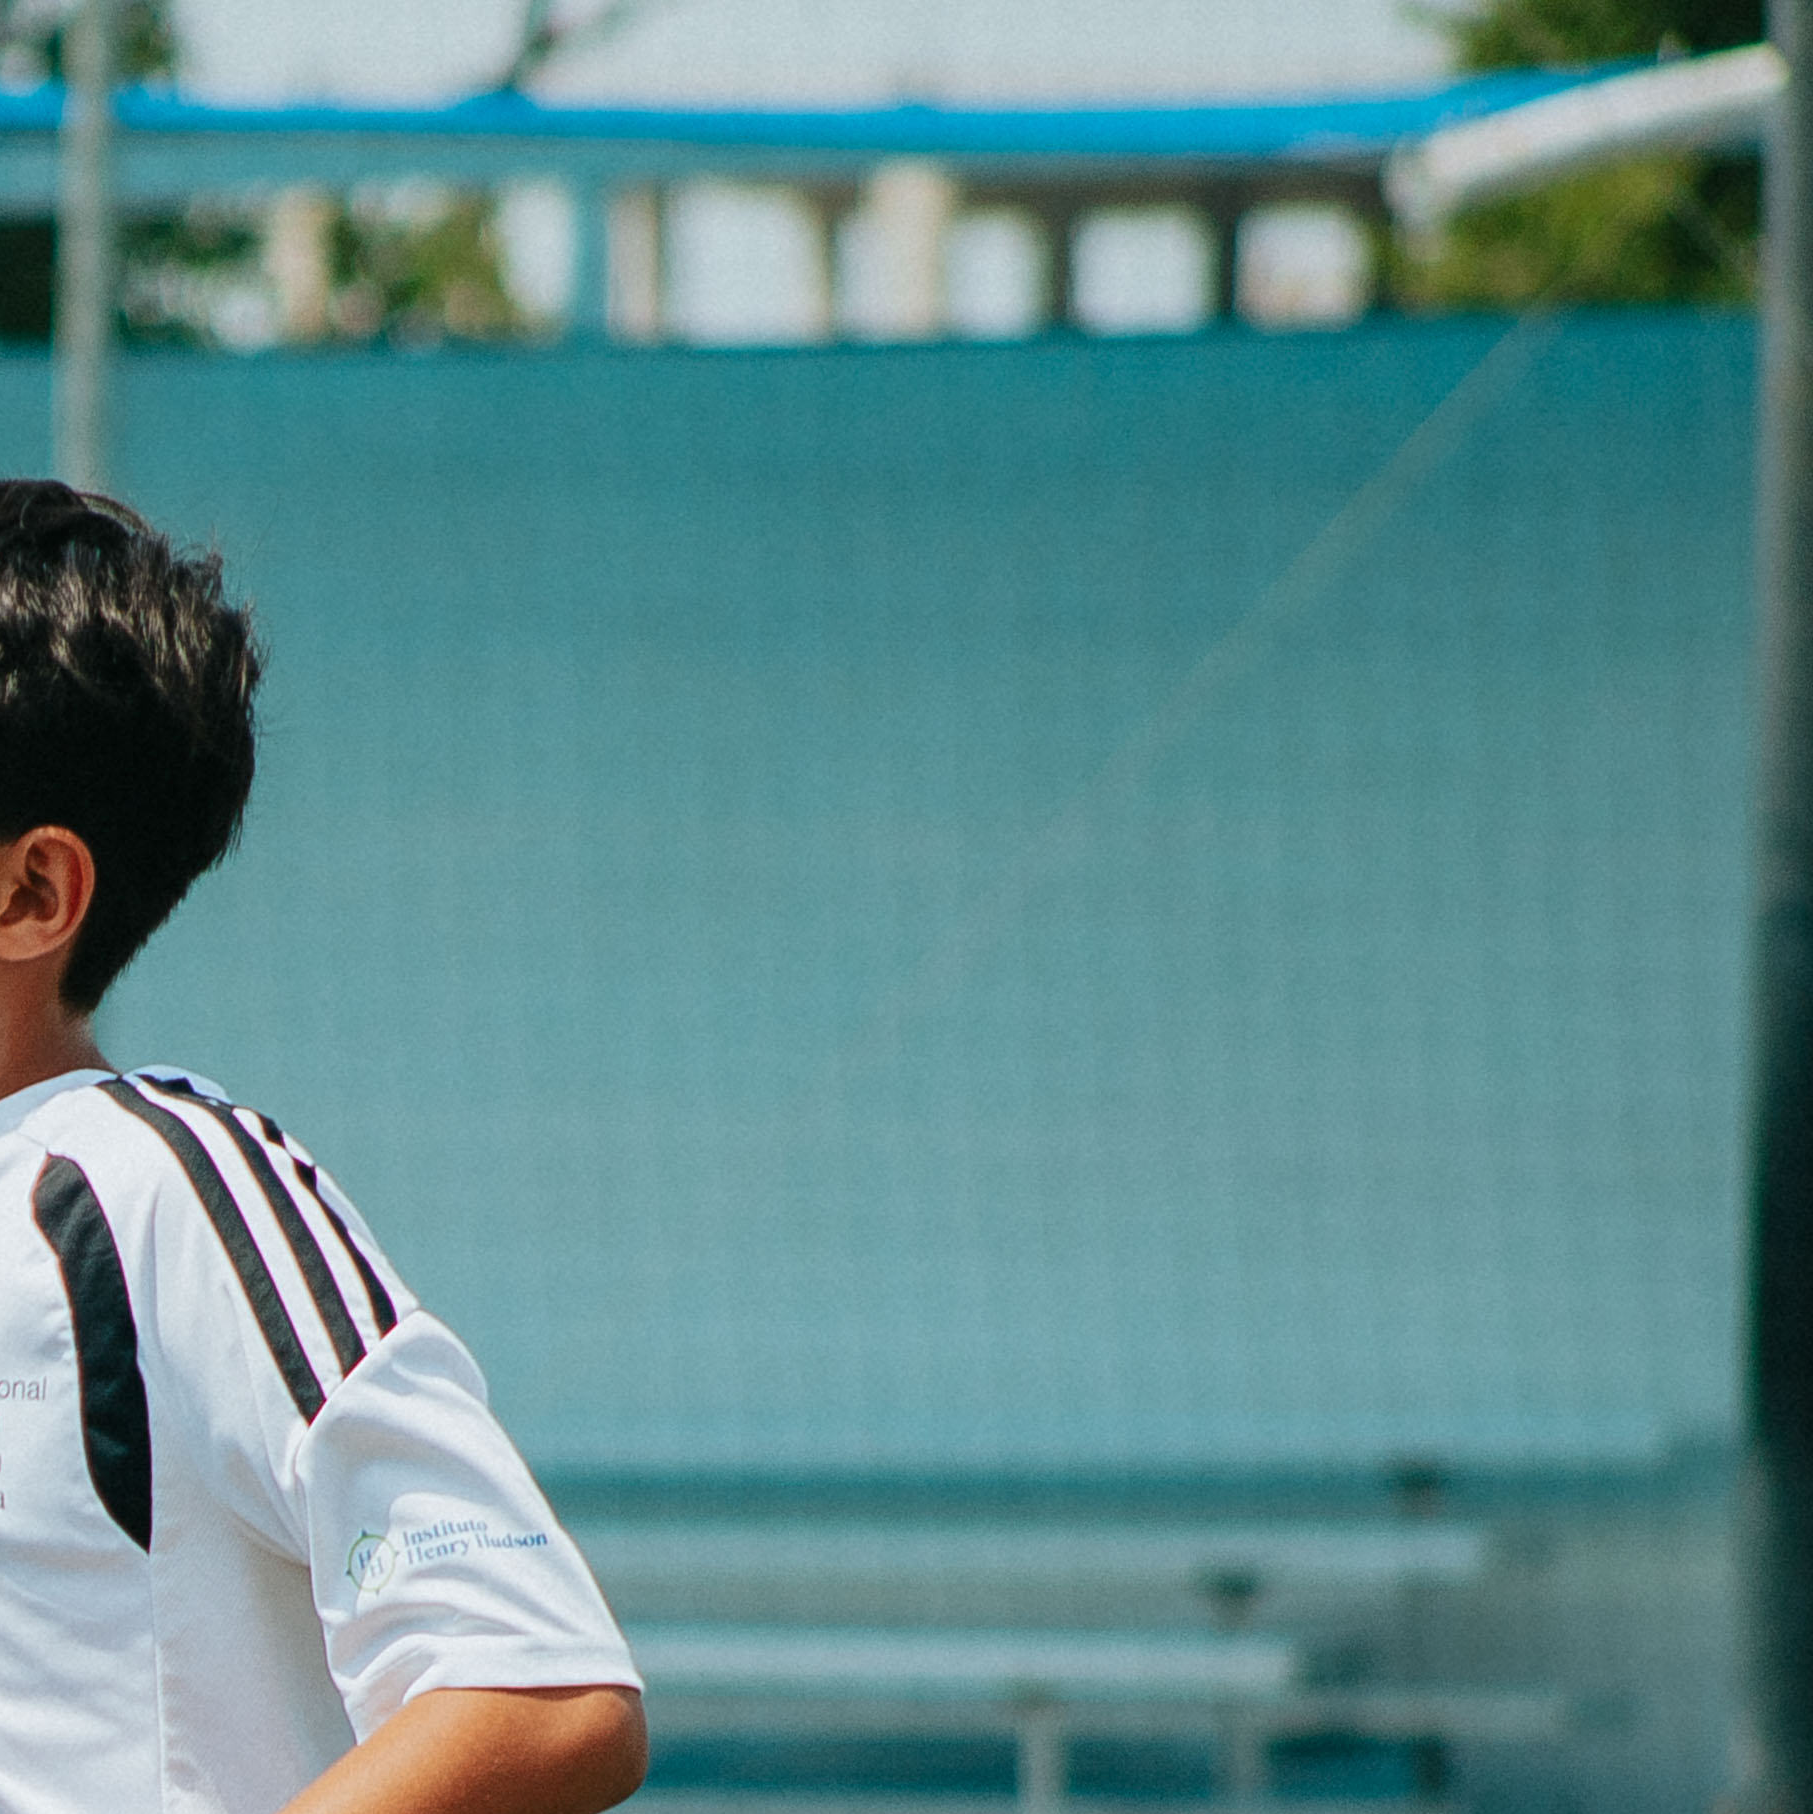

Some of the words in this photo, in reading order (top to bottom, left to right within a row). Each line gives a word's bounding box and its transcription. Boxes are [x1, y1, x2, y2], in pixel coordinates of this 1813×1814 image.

[403, 1519, 488, 1547] Instituto
[406, 1537, 471, 1566] Henry
[476, 1532, 548, 1549] Hudson
